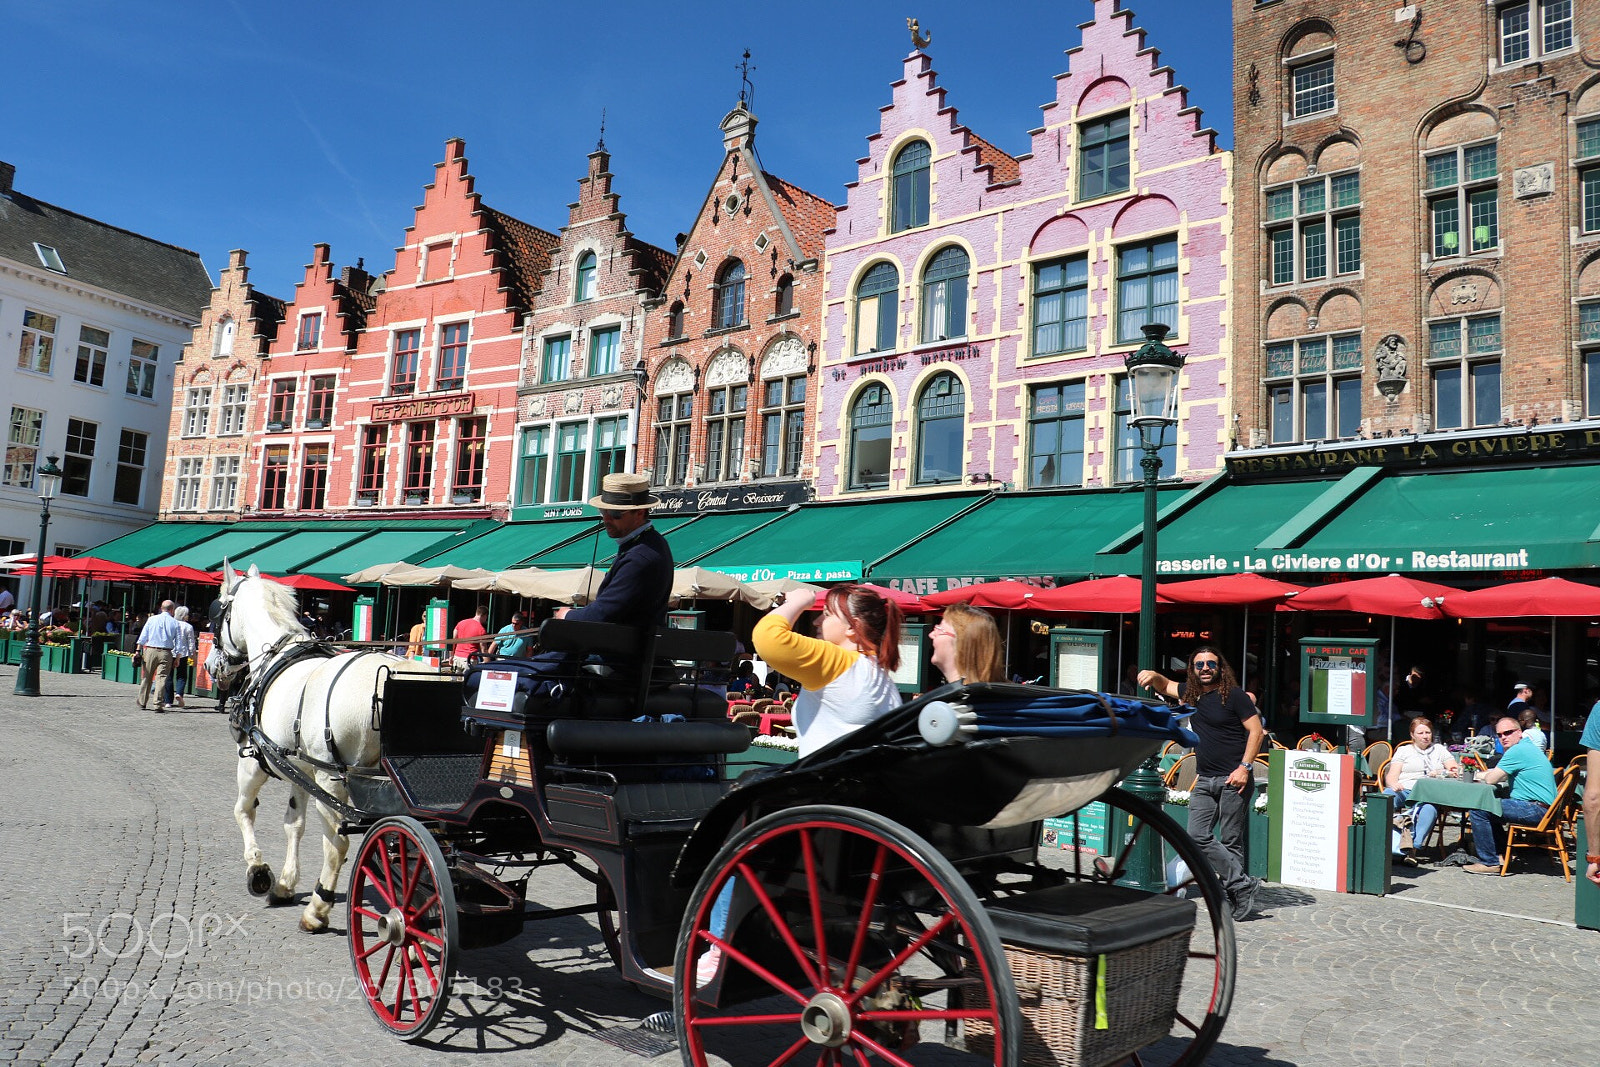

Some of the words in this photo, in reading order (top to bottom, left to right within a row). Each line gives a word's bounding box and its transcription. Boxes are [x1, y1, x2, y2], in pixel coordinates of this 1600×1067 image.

[920, 345, 980, 367] meermin
[375, 407, 390, 419] LE
[392, 401, 437, 418] PANIER
[440, 397, 471, 414] D'OR
[1232, 447, 1387, 474] RESTAURANT
[1402, 443, 1438, 460] LA
[1452, 432, 1566, 456] CIVIERE
[697, 491, 729, 511] Central
[743, 492, 784, 505] Brasserie
[543, 508, 560, 518] SINT
[561, 506, 583, 517] JORIS
[1156, 554, 1227, 572] rasserie
[1244, 555, 1267, 570] La
[1272, 553, 1342, 569] Civiere
[1346, 553, 1390, 569] d'Or
[1412, 548, 1529, 569] Restaurant
[716, 570, 748, 582] ene
[751, 568, 776, 581] d'Or
[788, 570, 811, 580] Pizza
[814, 569, 822, 580] &
[826, 570, 851, 581] pasta
[889, 577, 938, 595] CAFE
[999, 575, 1057, 590] TS
[1348, 648, 1369, 656] CAFE
[1289, 770, 1330, 781] ITALIAN
